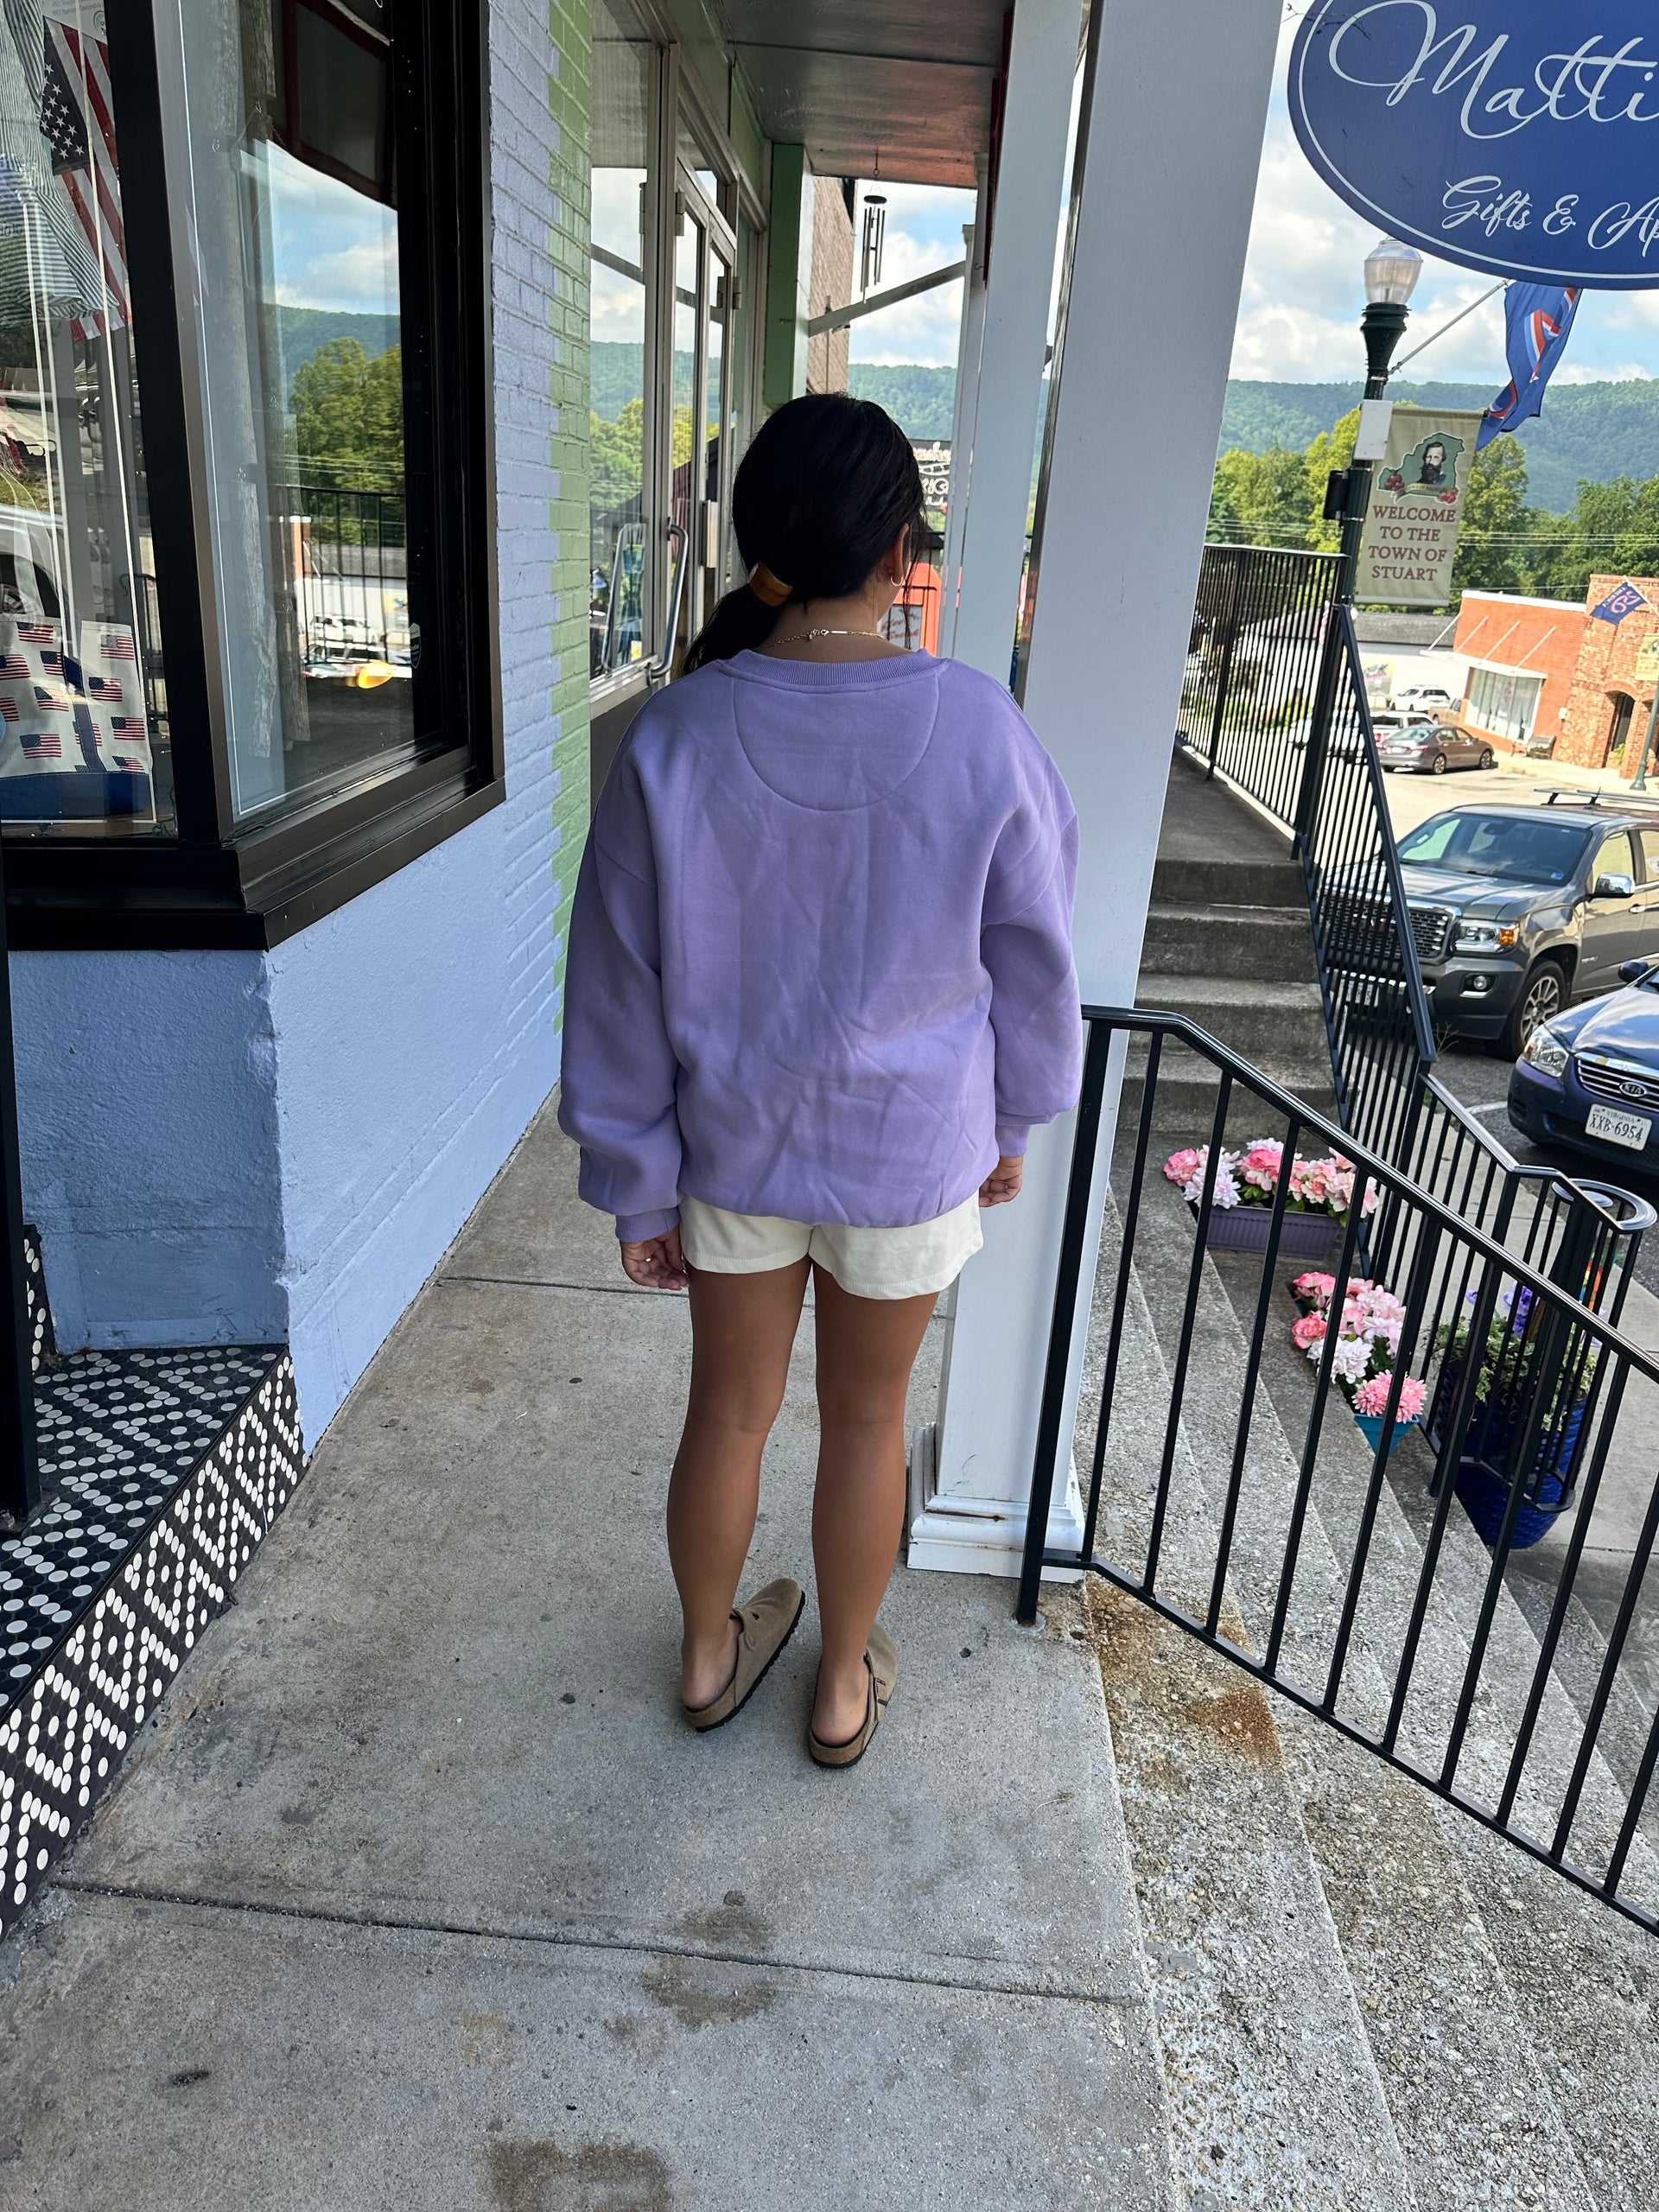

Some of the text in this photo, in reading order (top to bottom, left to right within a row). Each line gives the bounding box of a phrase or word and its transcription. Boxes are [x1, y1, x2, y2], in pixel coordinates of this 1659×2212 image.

[1441, 175, 1533, 237] Gifts
[1542, 194, 1580, 235] &
[1372, 505, 1456, 523] WELCOME
[1380, 525, 1440, 543] TO THE
[1368, 545, 1447, 562] TOWN OF
[1371, 565, 1437, 582] STUART
[1624, 1084, 1642, 1095] KIA
[1606, 1109, 1636, 1124] VIRGINIA
[1590, 1113, 1643, 1142] XXB-6954
